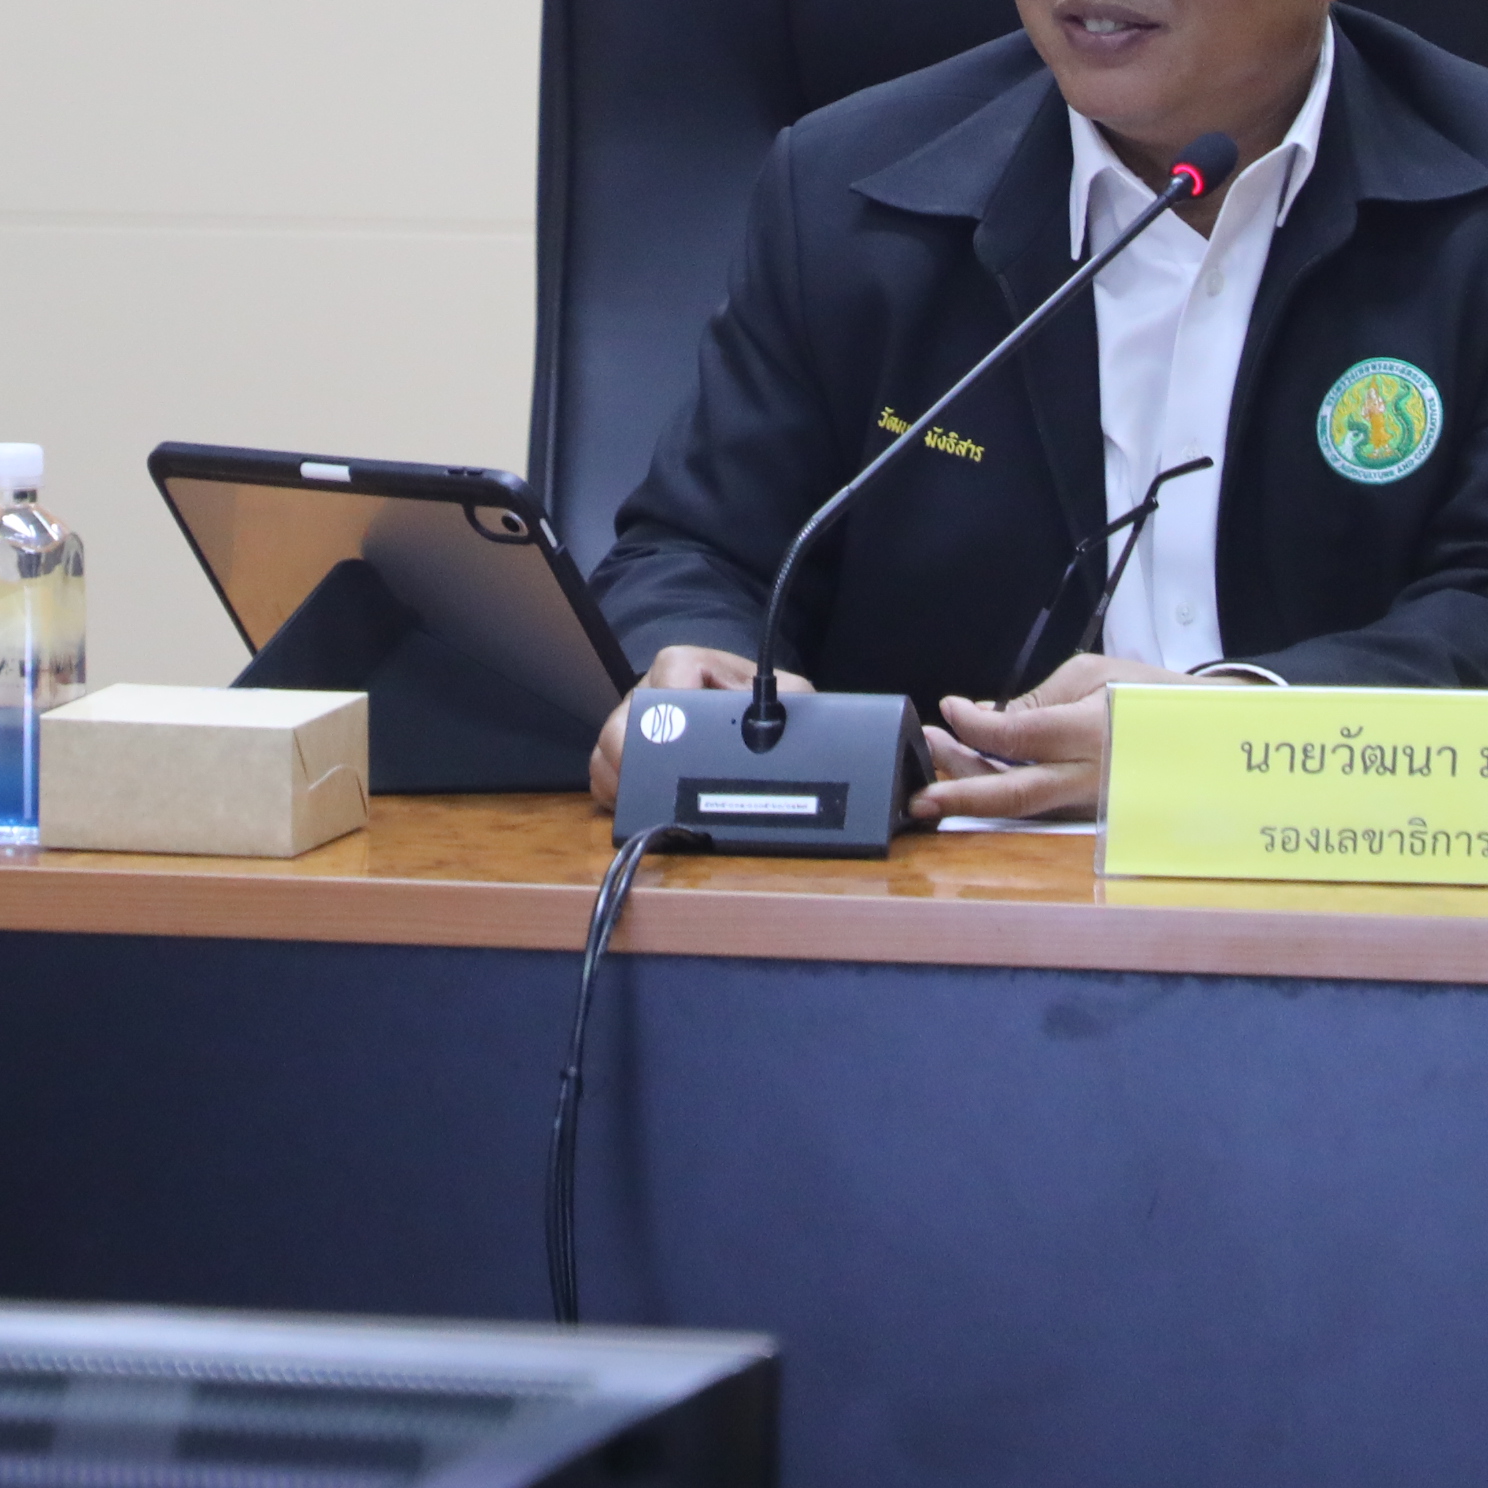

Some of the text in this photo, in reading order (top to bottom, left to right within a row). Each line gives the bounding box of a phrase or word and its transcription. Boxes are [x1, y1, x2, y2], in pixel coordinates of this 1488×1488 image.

[877, 406, 985, 462] วัฒ มังธิสาร
[1240, 725, 1458, 778] นายวัฒนา
